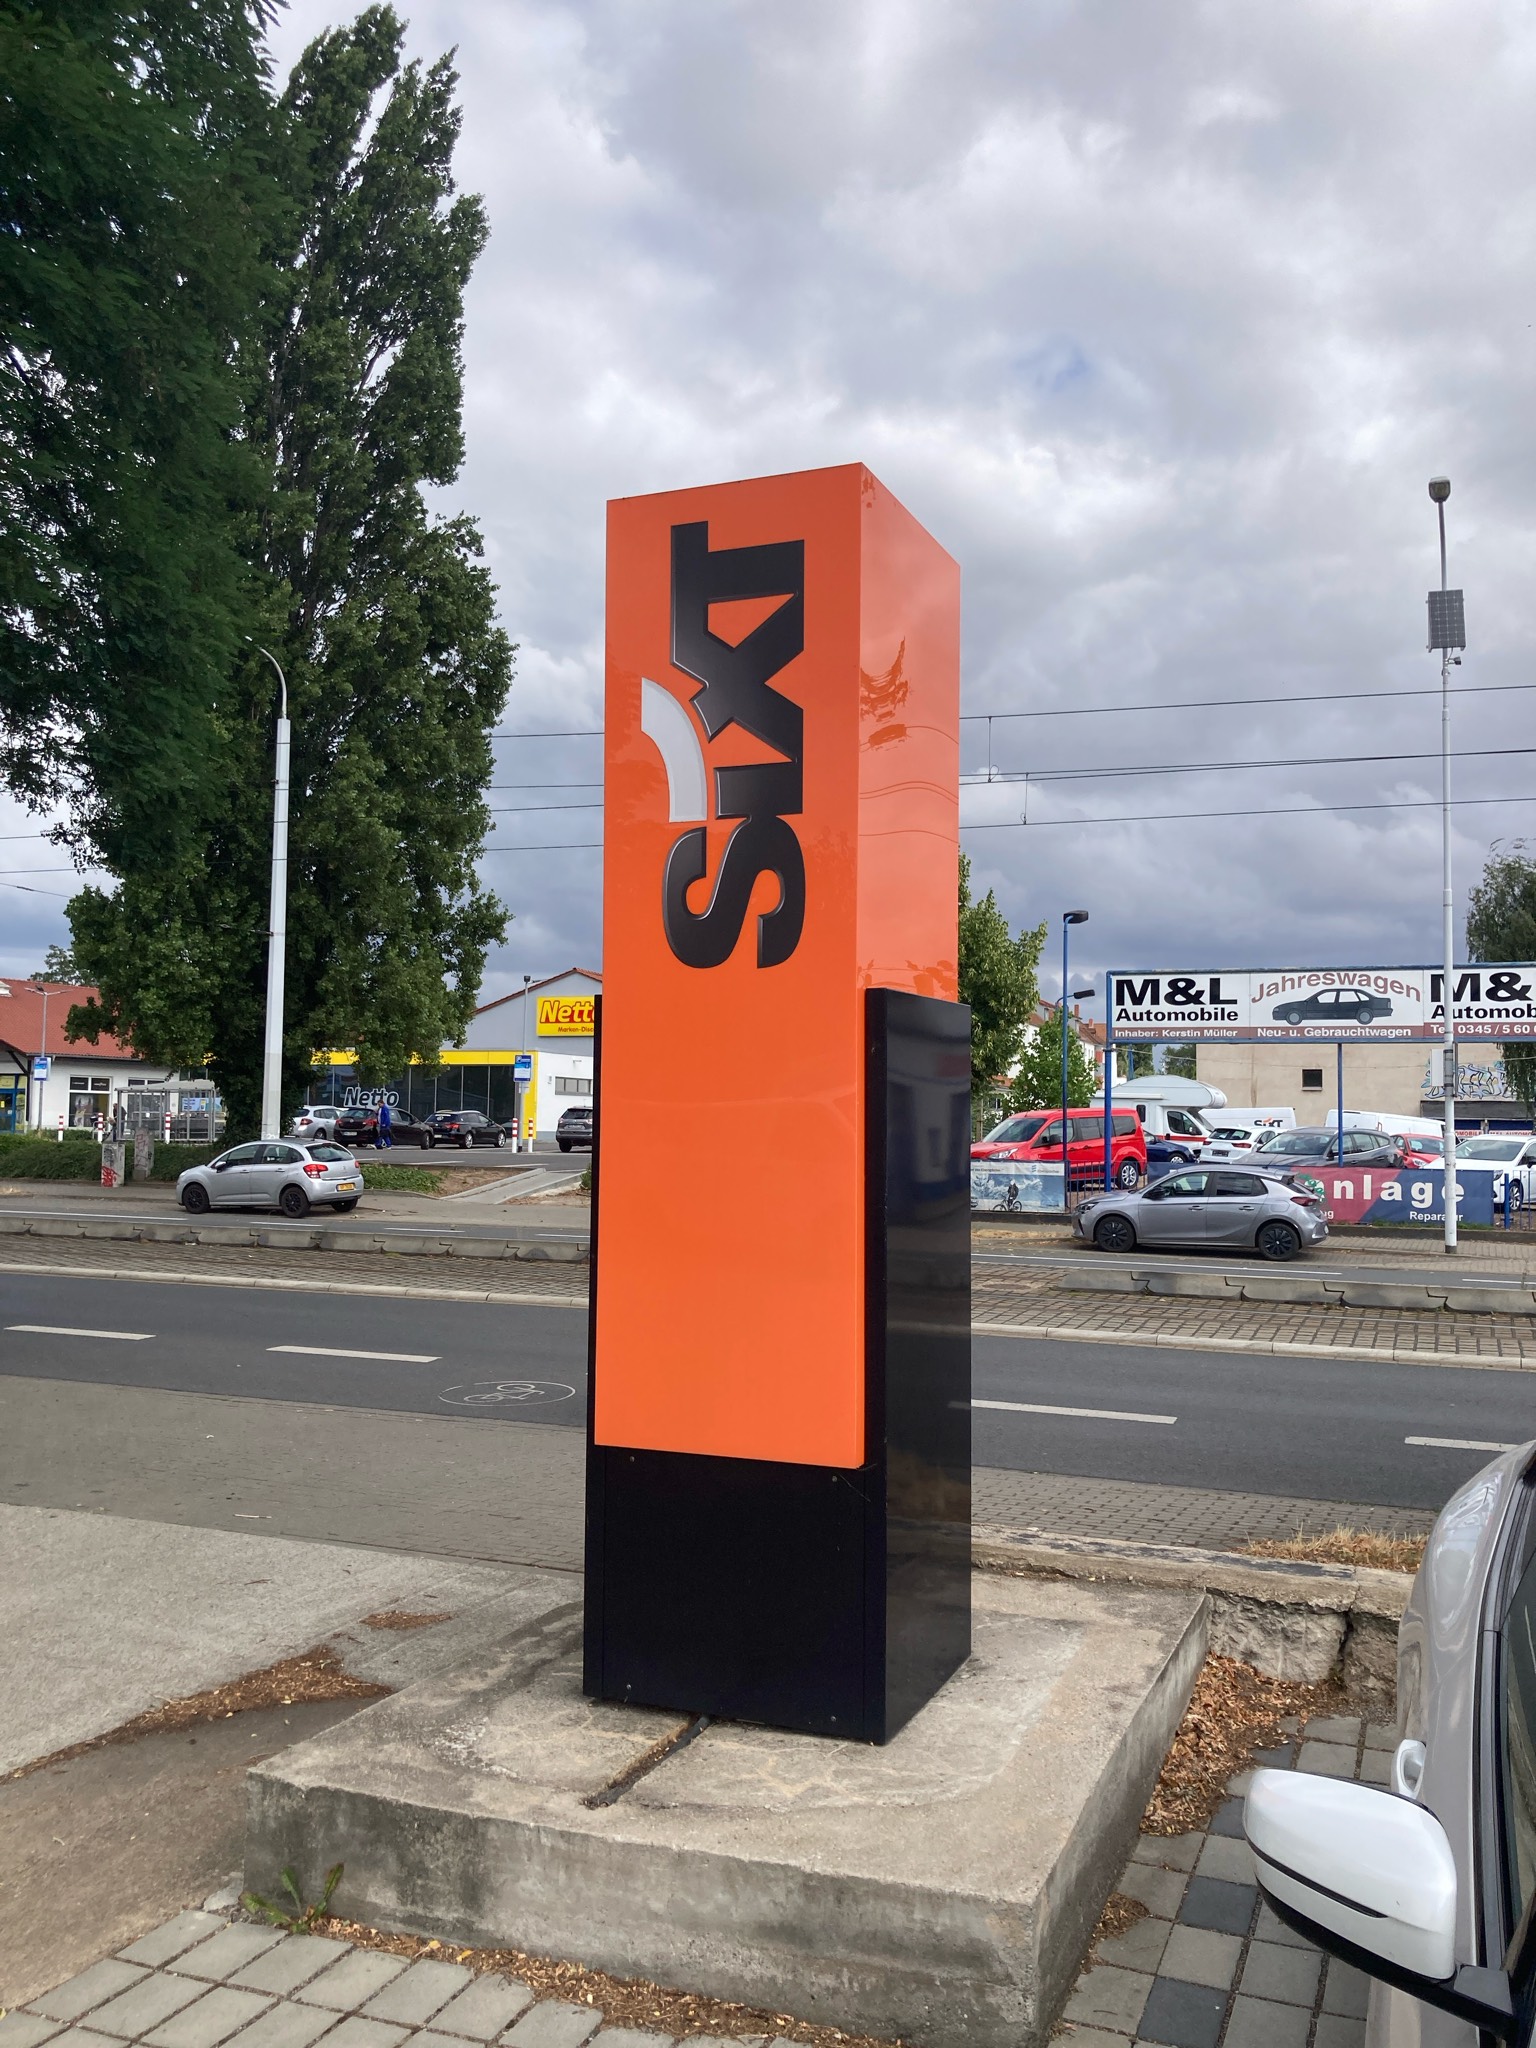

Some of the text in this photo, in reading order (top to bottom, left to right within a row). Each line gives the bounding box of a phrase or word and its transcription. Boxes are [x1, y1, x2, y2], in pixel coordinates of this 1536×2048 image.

[1116, 978, 1238, 1006] M&L
[1251, 972, 1421, 1003] Jahreswagen
[540, 1000, 594, 1023] Nett
[1116, 1007, 1239, 1021] Automobile
[1115, 1029, 1238, 1038] Inhaber: Kerstin Müller
[1257, 1027, 1412, 1038] Neu- u. Gebrauchtwagen
[1457, 1024, 1492, 1034] 0345
[344, 1086, 400, 1108] Netto
